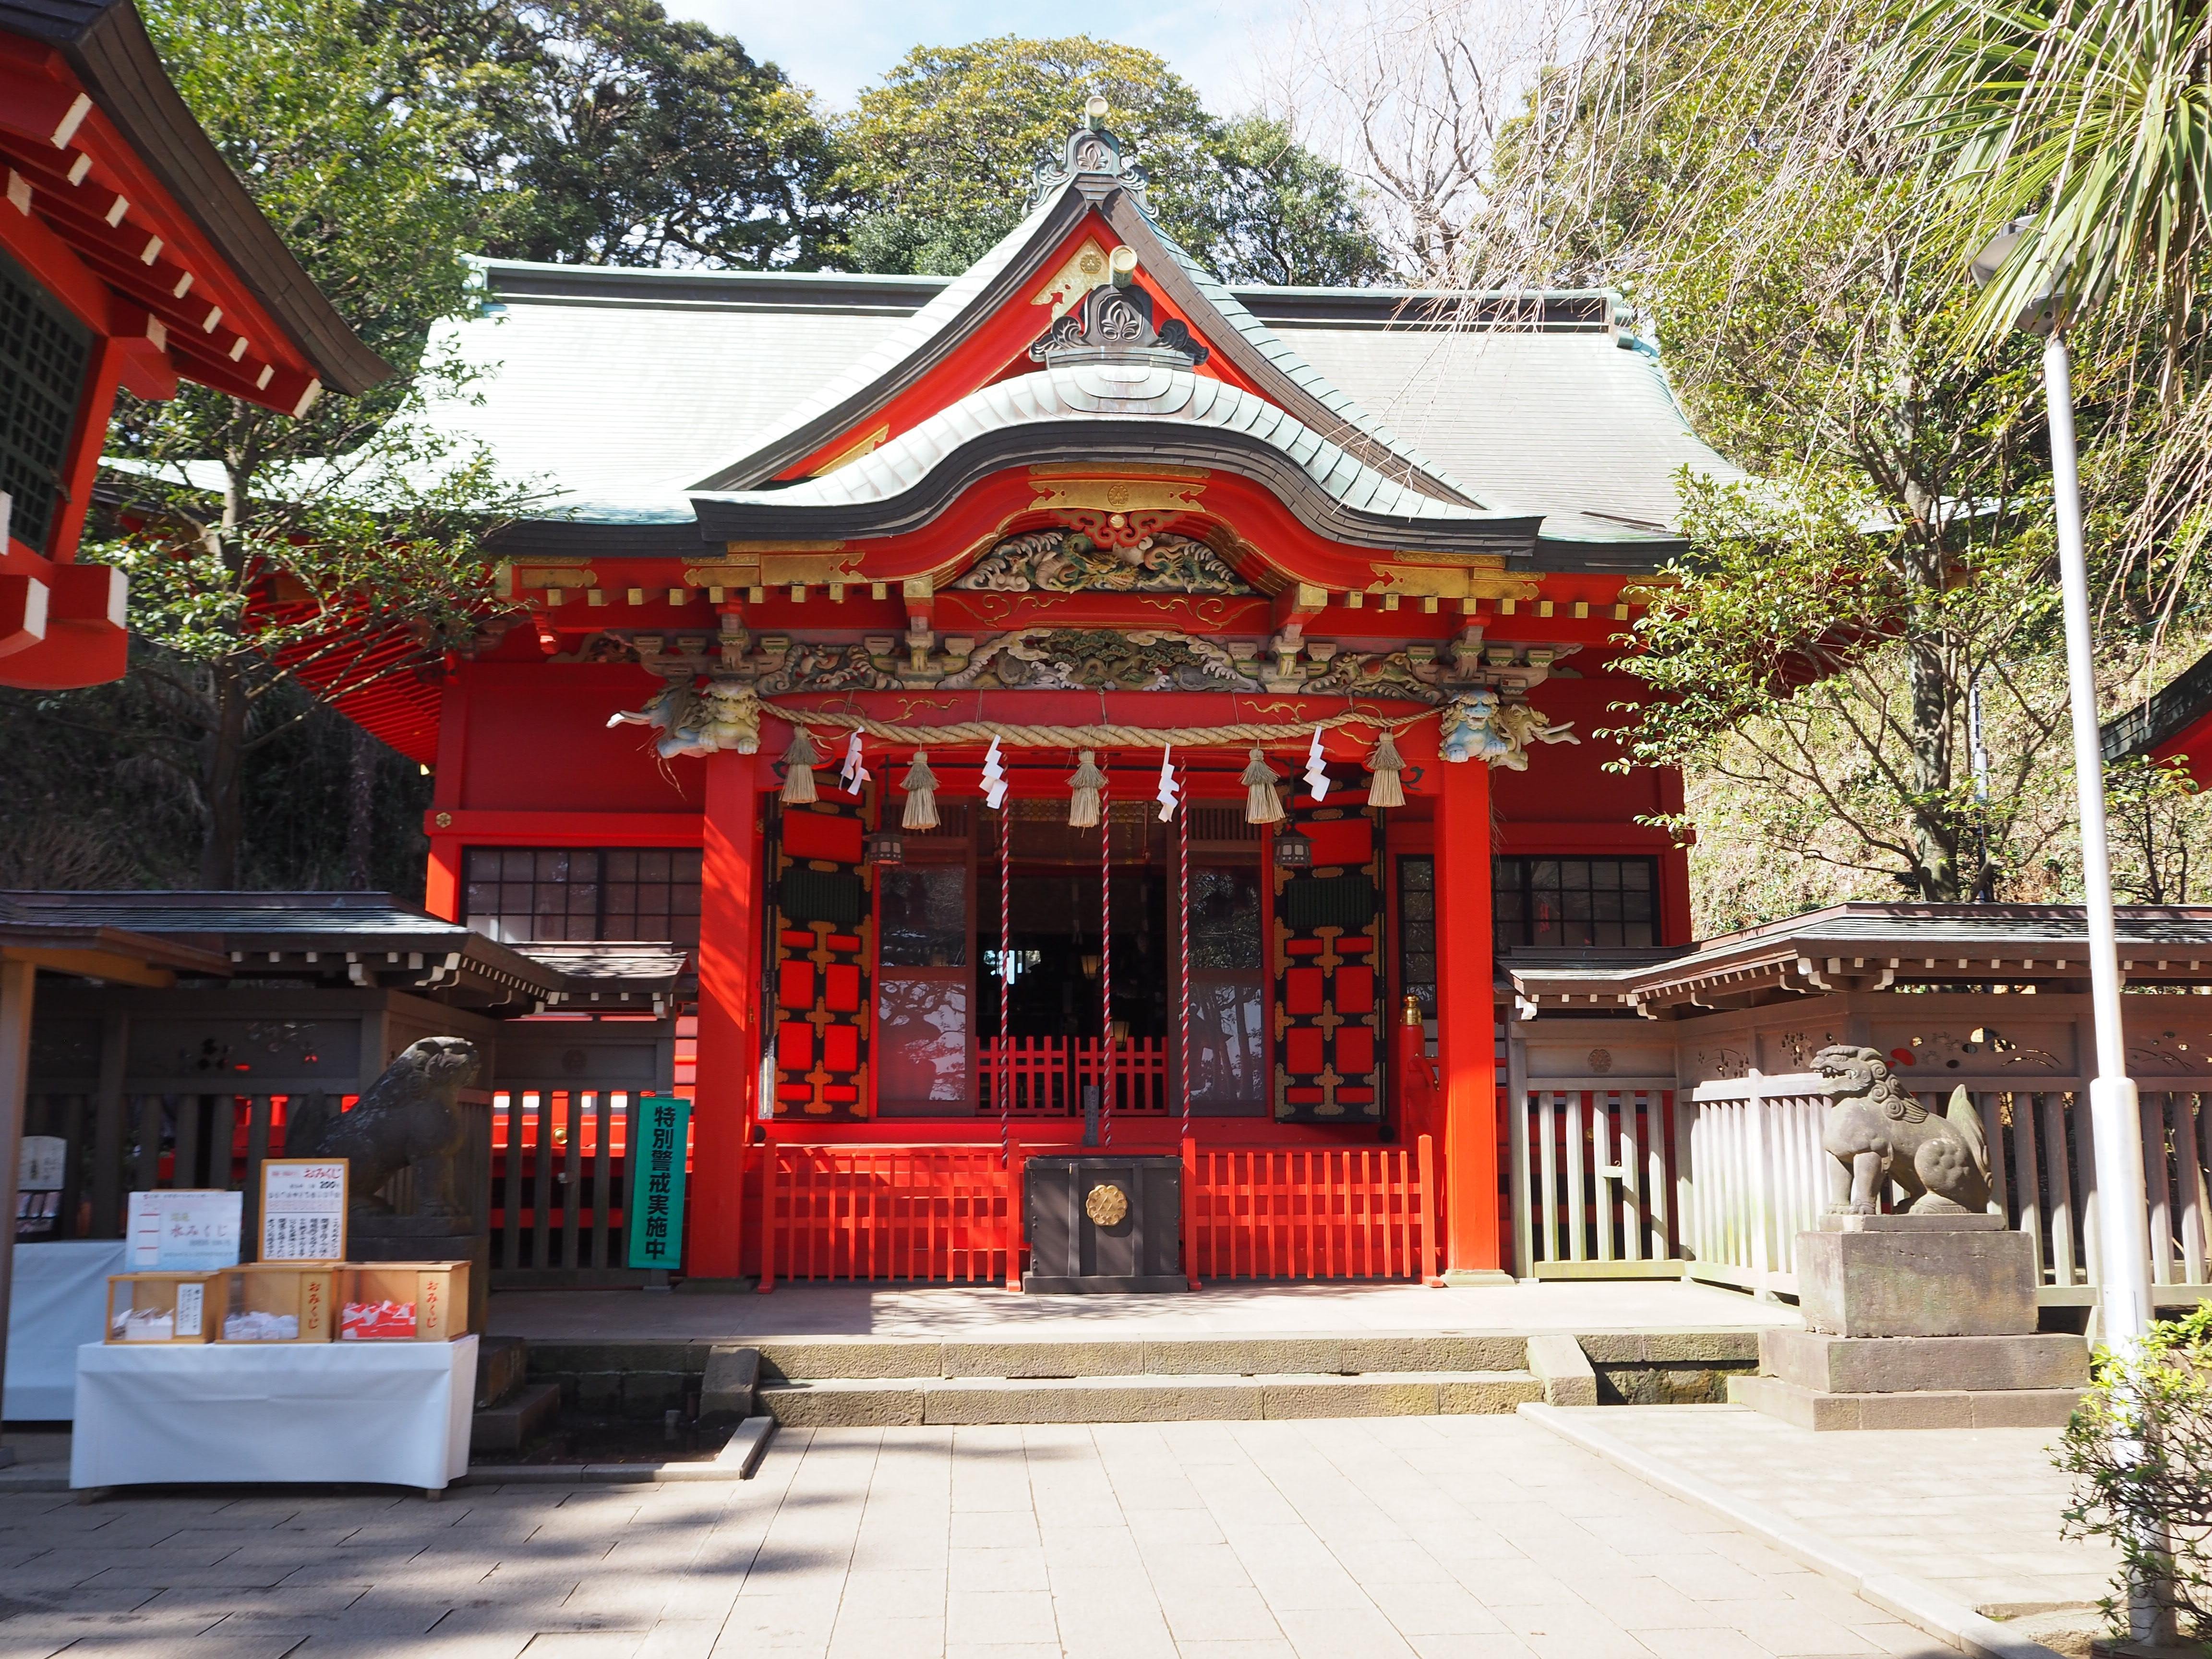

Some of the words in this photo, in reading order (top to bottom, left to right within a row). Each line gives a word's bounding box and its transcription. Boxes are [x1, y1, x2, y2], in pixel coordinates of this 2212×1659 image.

[303, 1167, 342, 1179] おみくじ
[645, 1106, 676, 1260] 特別警戒実施中
[170, 1224, 228, 1238] 水みくじ
[309, 1282, 321, 1329] おみくじ
[426, 1281, 438, 1328] おみくじ
